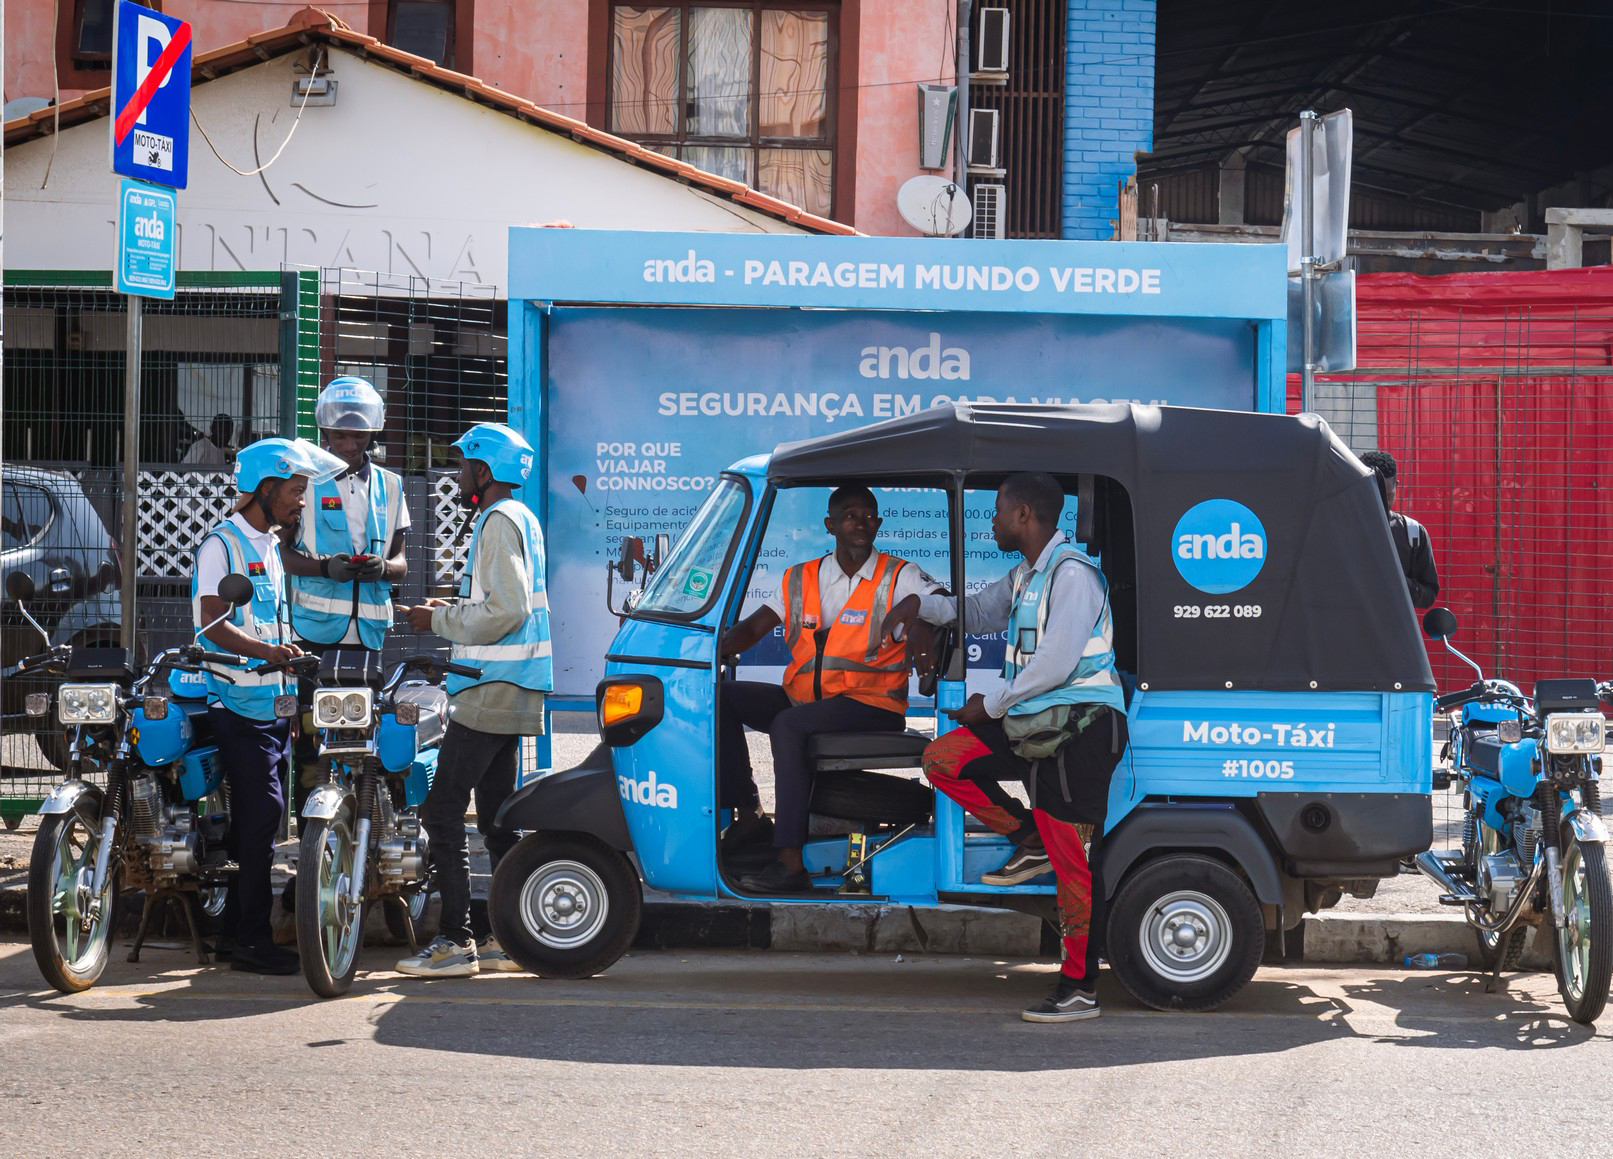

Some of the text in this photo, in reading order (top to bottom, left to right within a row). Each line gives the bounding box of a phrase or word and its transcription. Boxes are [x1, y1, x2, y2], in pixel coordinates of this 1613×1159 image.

[135, 133, 172, 153] MOTO-TÁXI
[134, 210, 164, 240] anda
[643, 249, 715, 284] anda
[744, 260, 904, 289] PARAGEM
[915, 263, 1040, 292] MUNDO
[1049, 267, 1161, 295] VERDE
[858, 332, 971, 381] anda
[658, 392, 920, 423] SEGURANÇA EM
[596, 442, 682, 457] POR QUE
[596, 459, 666, 474] VIAJAR
[596, 476, 715, 491] CONNOSCO?
[606, 505, 698, 518] Seguro de acid
[882, 507, 899, 518] de
[902, 507, 931, 519] bens
[893, 527, 937, 541] rápidas
[1177, 522, 1264, 560] anda
[1173, 604, 1262, 618] 929 622 089
[1182, 720, 1336, 748] Moto-Táxi
[1221, 759, 1295, 779] #1005
[618, 770, 678, 809] anda
